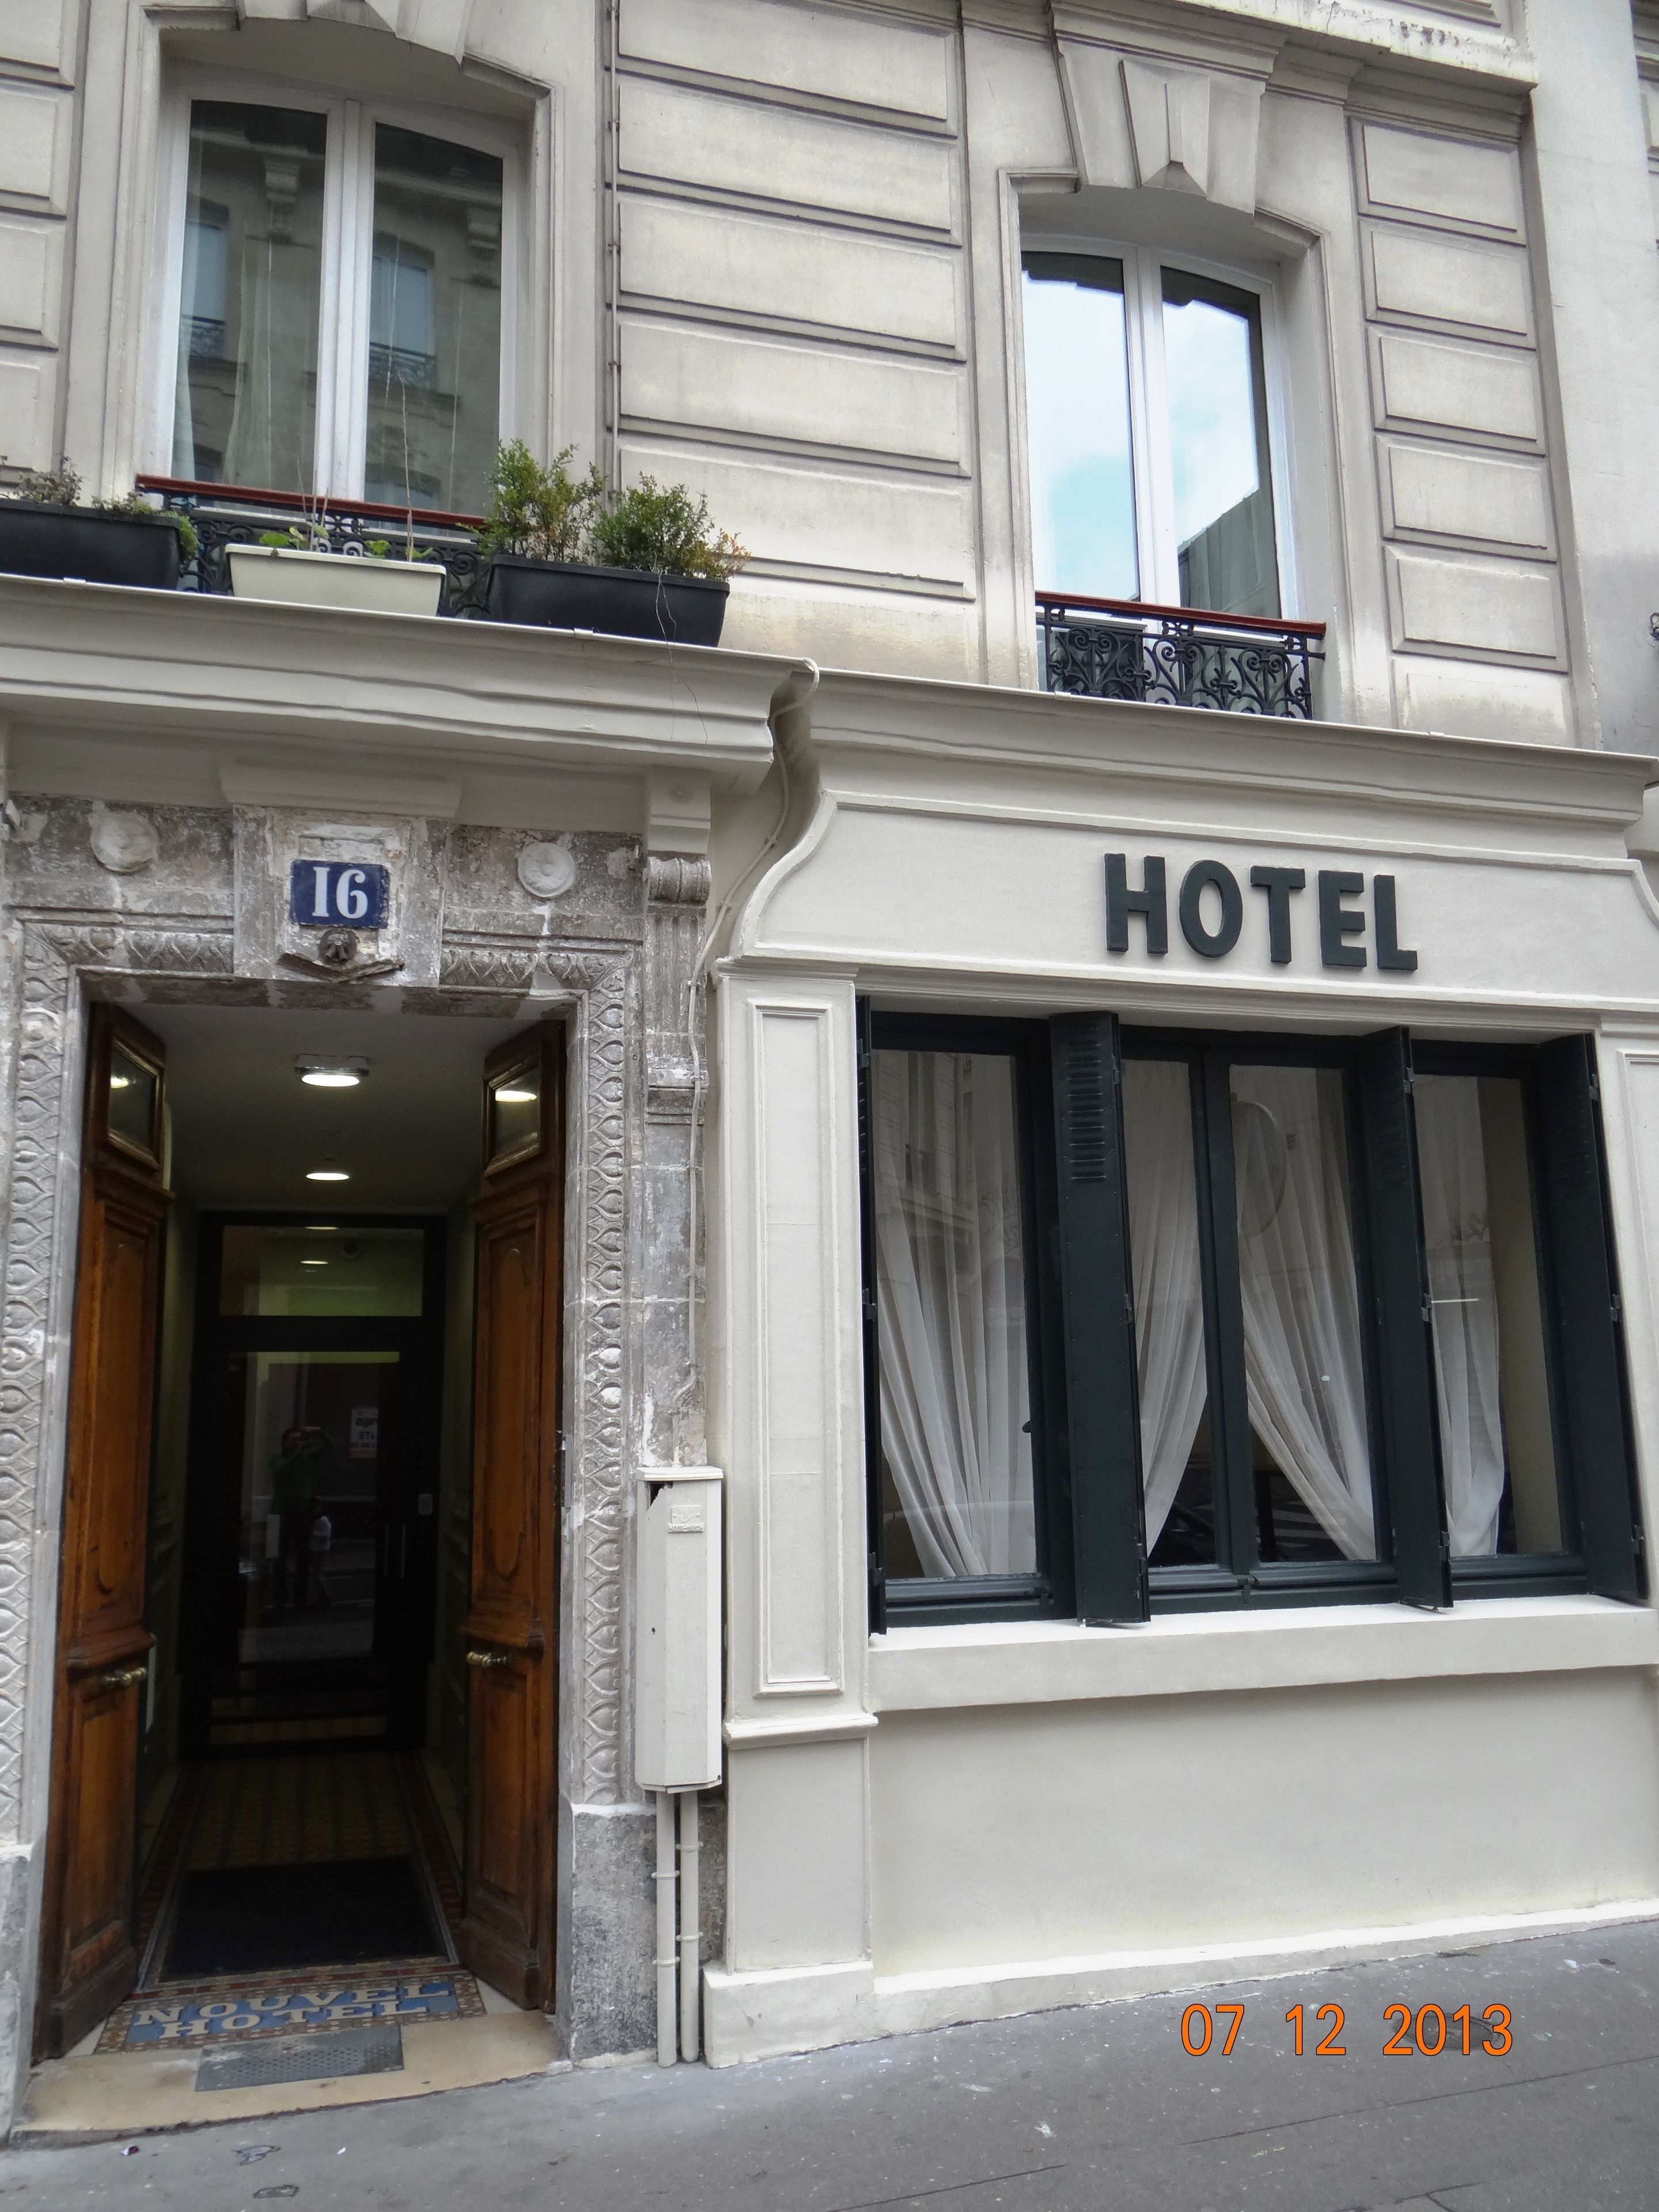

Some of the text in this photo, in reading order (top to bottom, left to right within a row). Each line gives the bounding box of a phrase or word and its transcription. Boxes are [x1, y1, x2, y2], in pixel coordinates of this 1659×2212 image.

[312, 866, 368, 919] 16
[1104, 853, 1418, 971] HOTEL
[134, 1984, 449, 2025] NOUVEL
[158, 2001, 427, 2039] HOTEL
